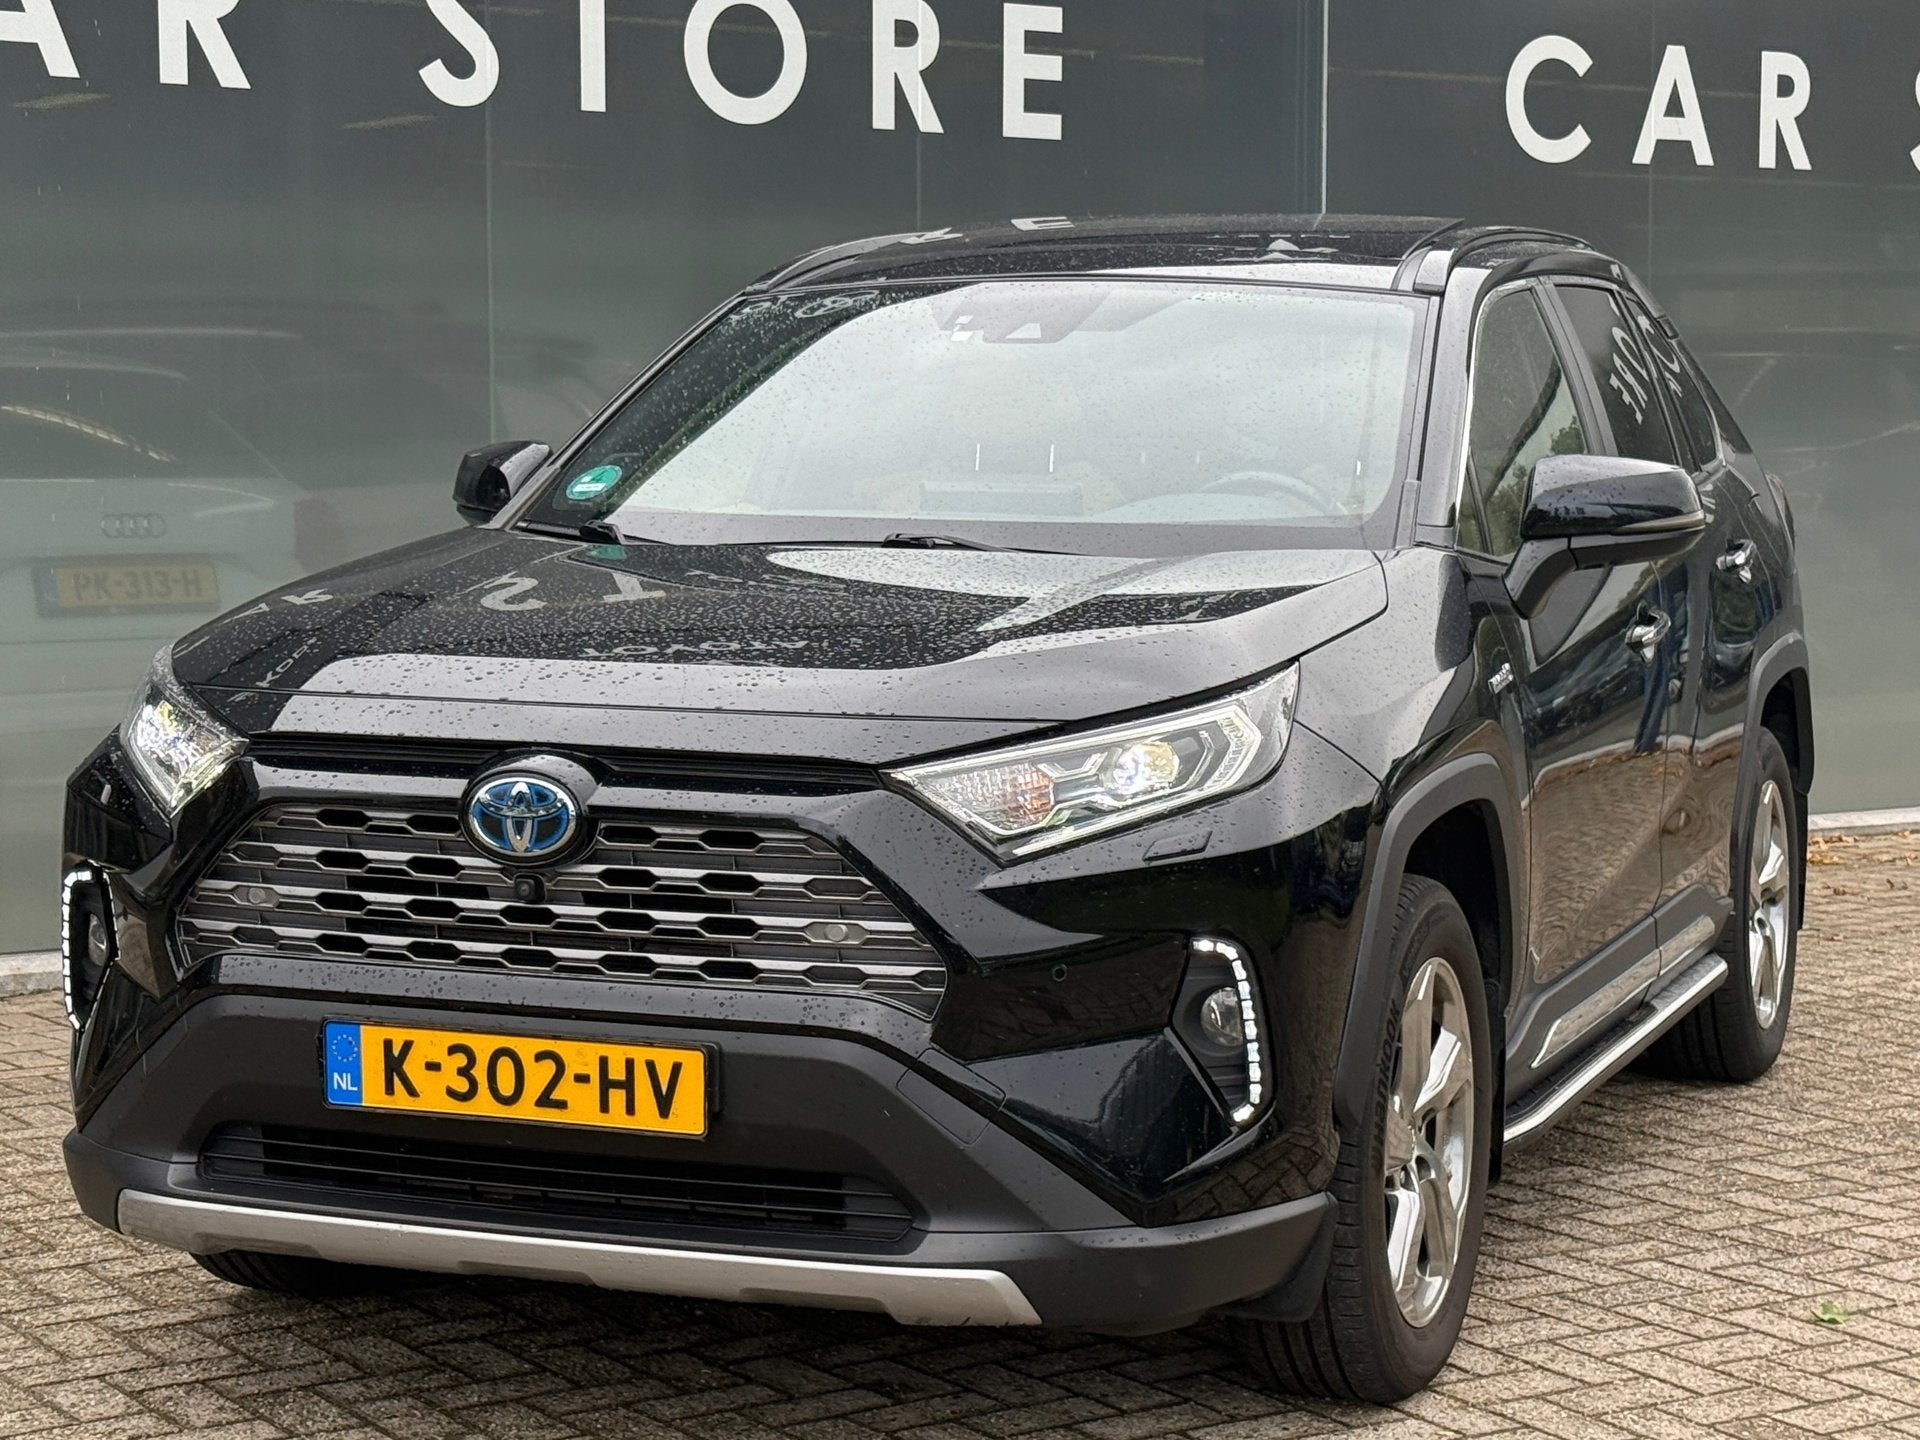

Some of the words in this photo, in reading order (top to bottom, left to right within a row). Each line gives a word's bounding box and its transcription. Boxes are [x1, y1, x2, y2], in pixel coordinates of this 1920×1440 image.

[1506, 35, 1813, 171] CAR
[72, 568, 203, 601] PK-313-H
[333, 1072, 358, 1091] NL
[383, 1038, 683, 1119] K-302-HV
